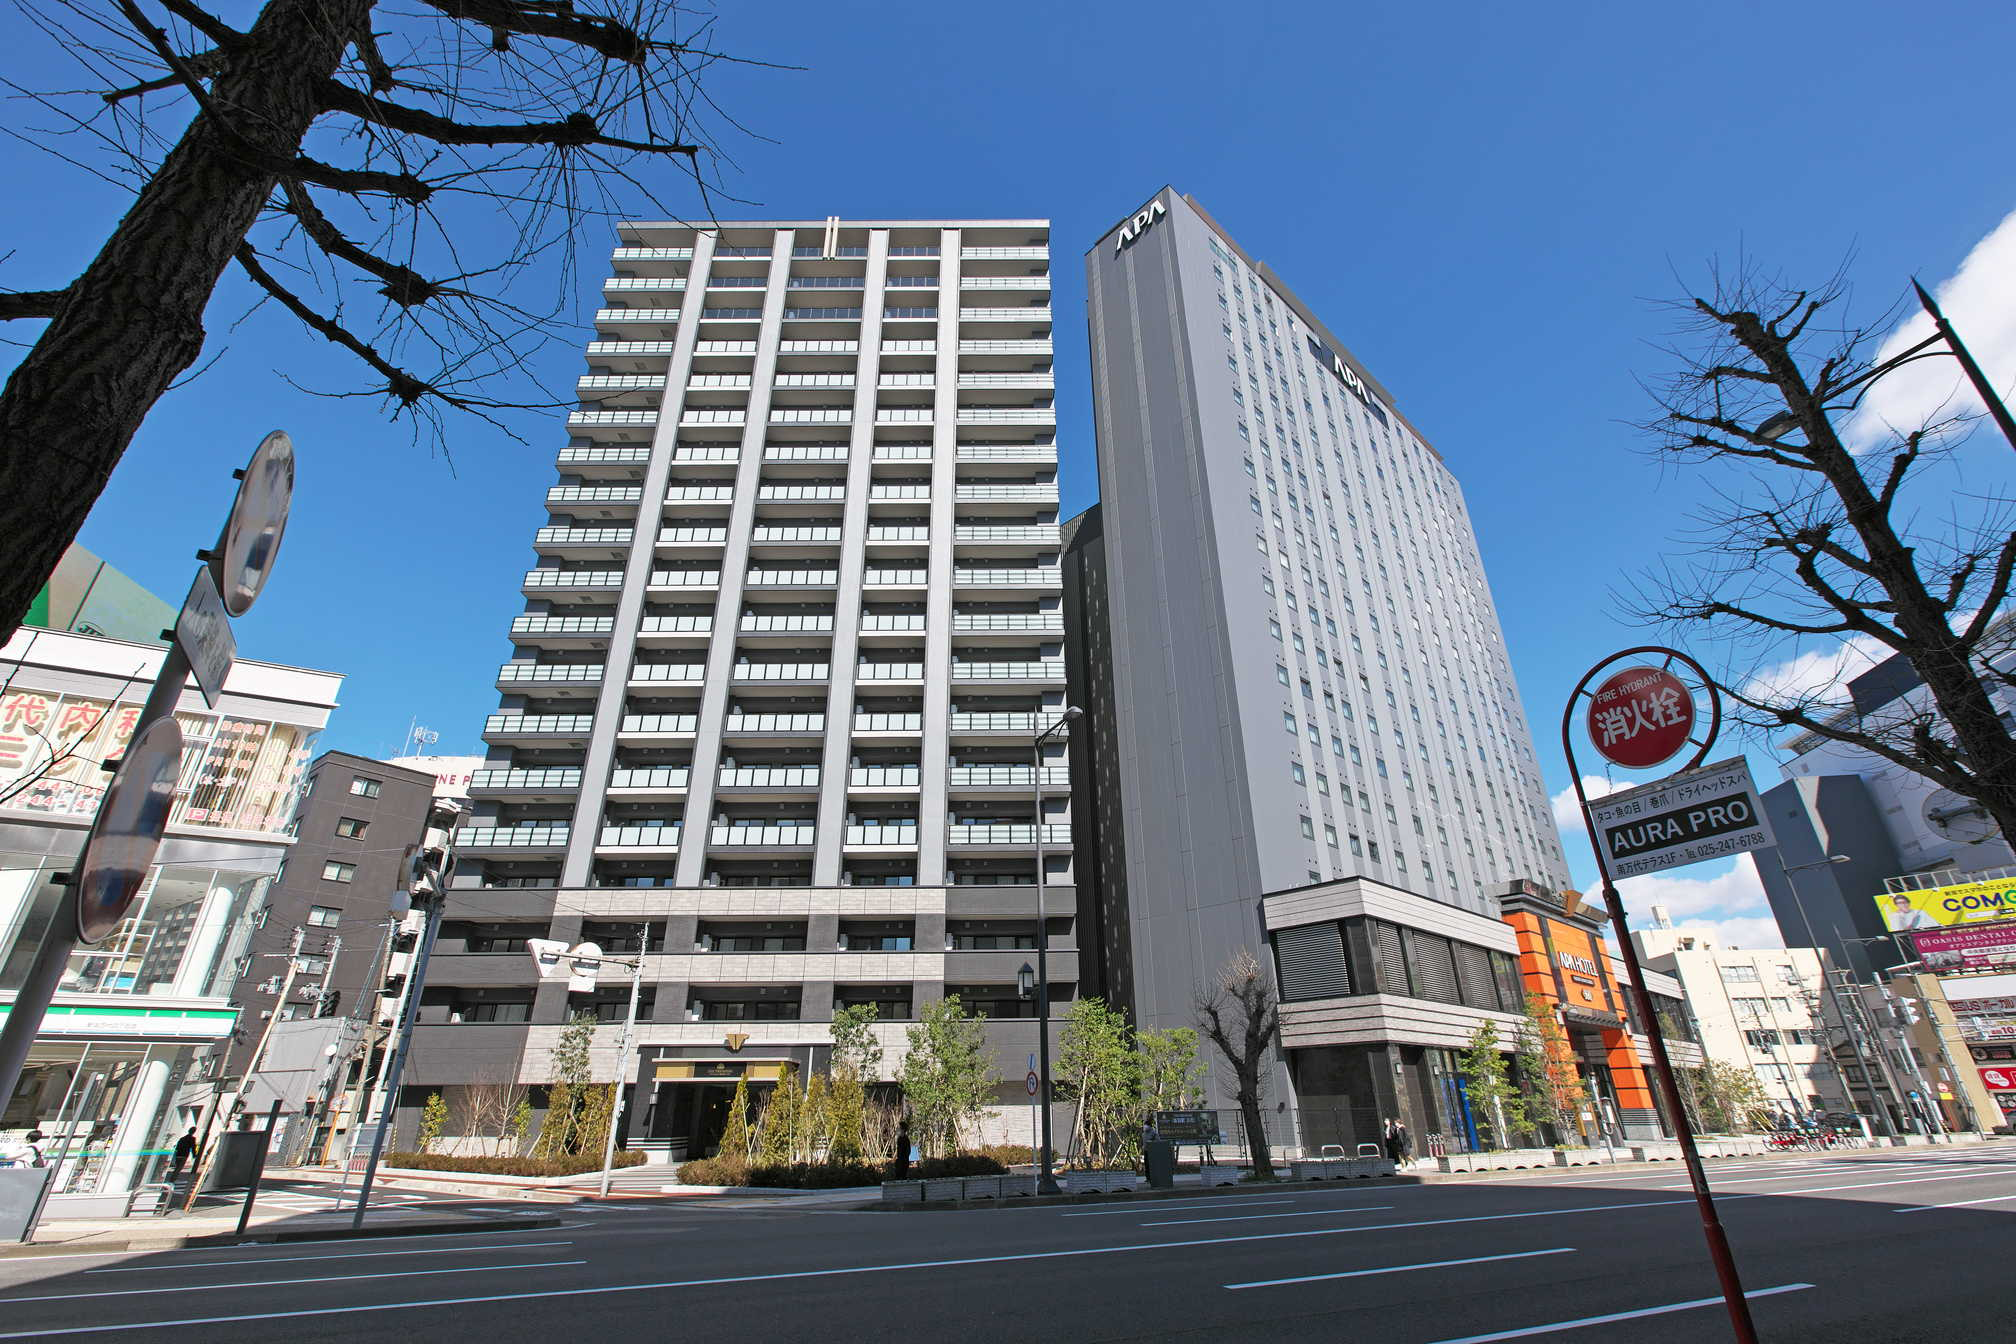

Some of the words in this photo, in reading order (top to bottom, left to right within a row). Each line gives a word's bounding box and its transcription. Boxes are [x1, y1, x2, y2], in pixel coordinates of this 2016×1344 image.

[1116, 200, 1166, 251] APA
[1334, 353, 1370, 404] APA
[1596, 690, 1618, 704] FIRE
[1618, 672, 1663, 696] HYDRANT
[1594, 687, 1687, 747] 消火栓
[1613, 817, 1684, 851] AURA
[1688, 800, 1749, 833] PRO
[1698, 832, 1765, 856] 025-247-6788
[1964, 930, 2009, 941] DENTAL
[1575, 955, 1599, 977] HOTEL
